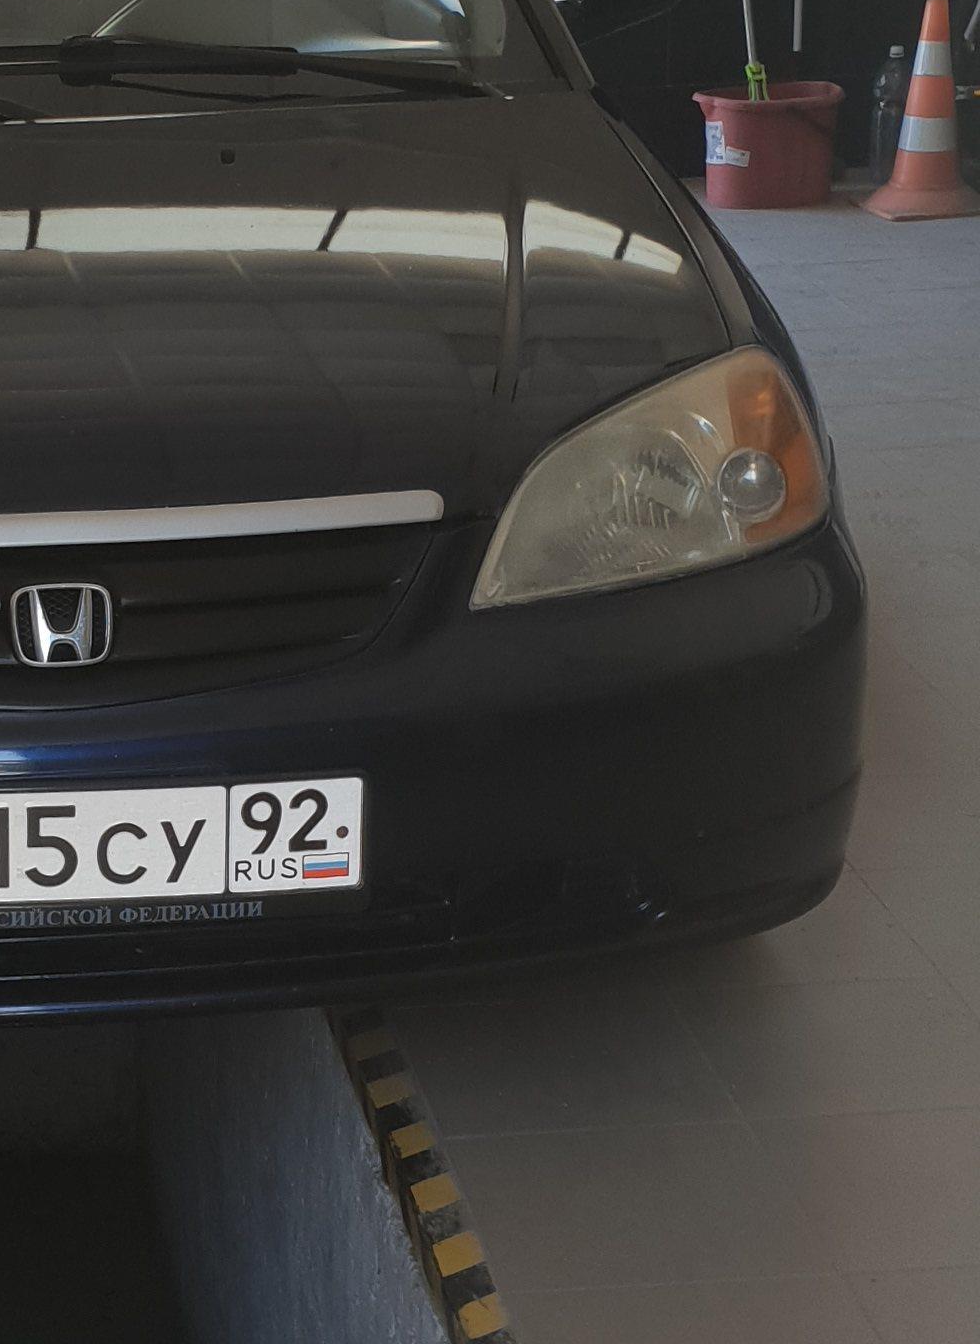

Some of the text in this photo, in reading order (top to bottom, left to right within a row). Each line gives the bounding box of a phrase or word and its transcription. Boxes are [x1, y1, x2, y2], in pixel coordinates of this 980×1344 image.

[240, 787, 330, 855] 92
[233, 858, 299, 882] RUS
[118, 900, 264, 924] ФЕДЕРАЦИИ
